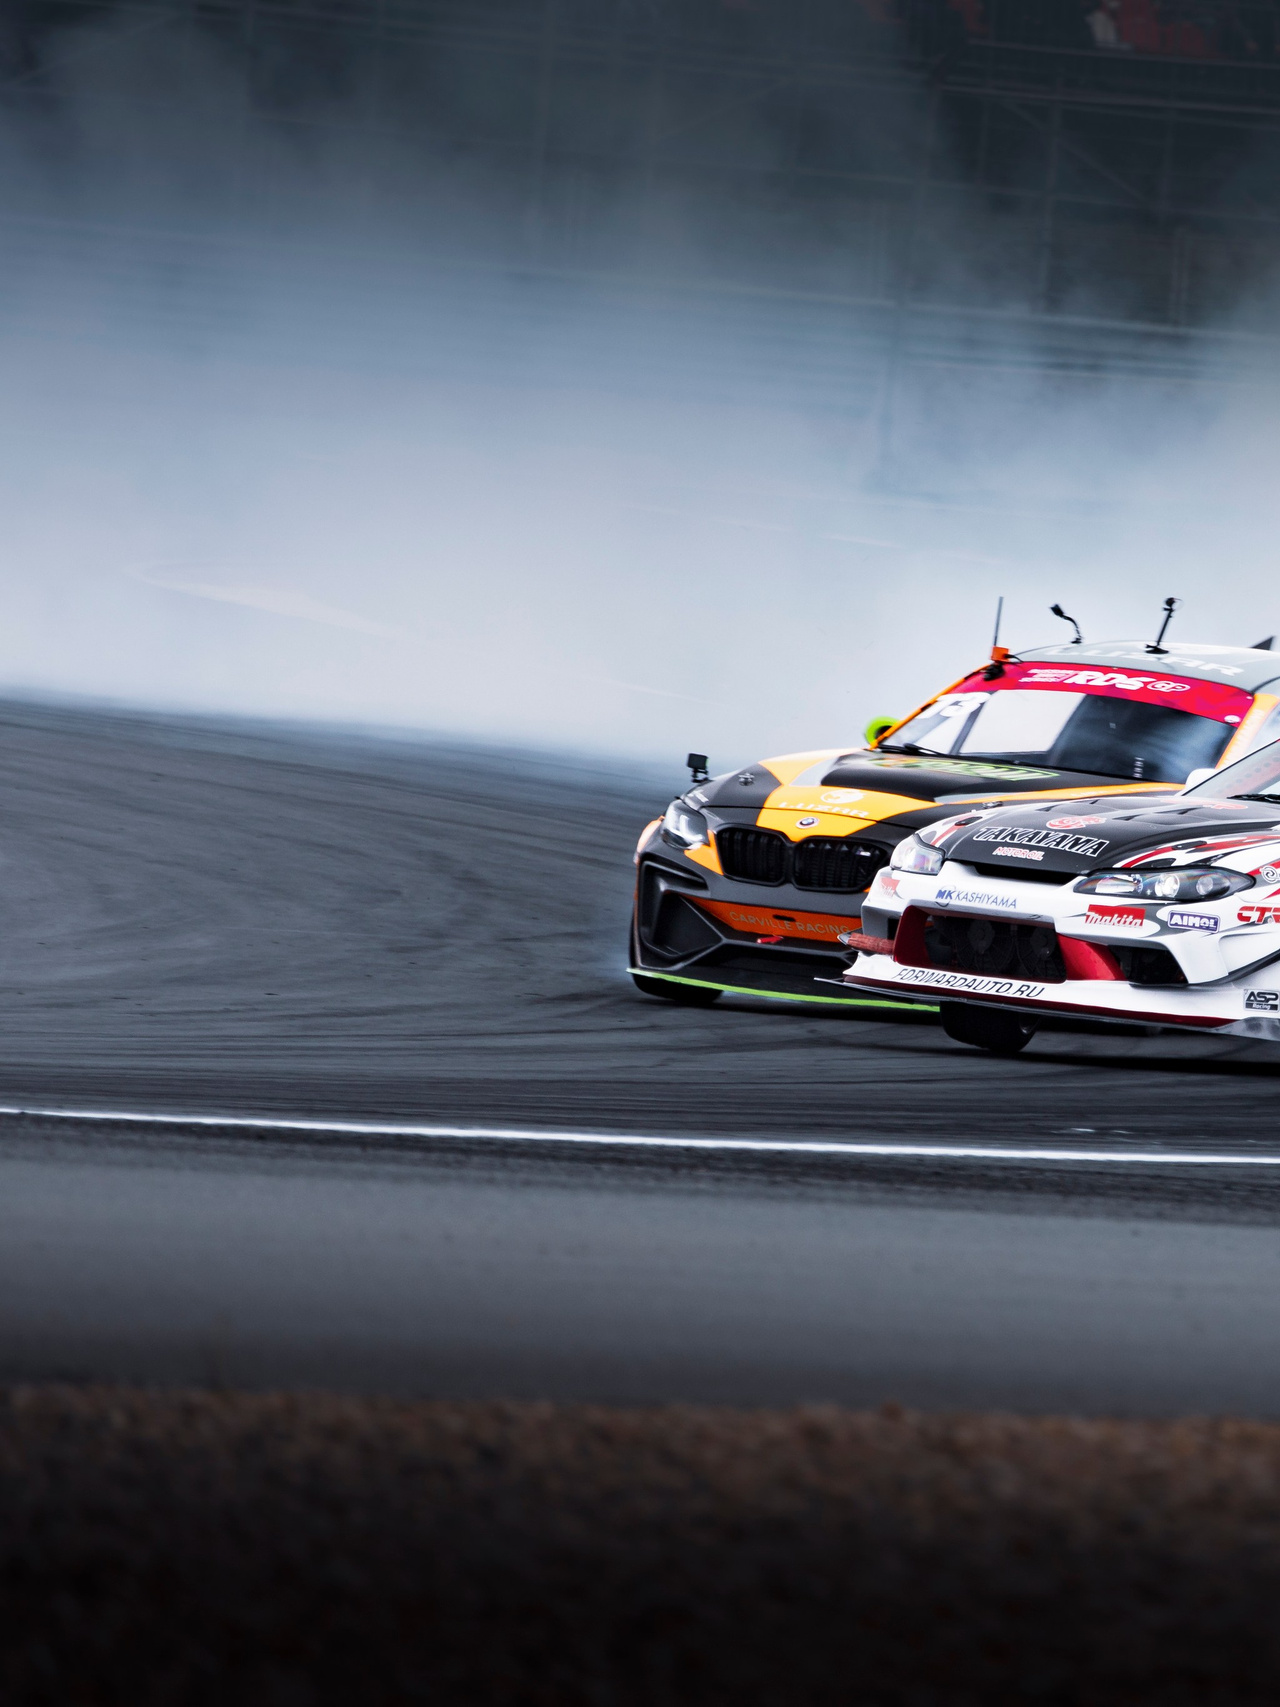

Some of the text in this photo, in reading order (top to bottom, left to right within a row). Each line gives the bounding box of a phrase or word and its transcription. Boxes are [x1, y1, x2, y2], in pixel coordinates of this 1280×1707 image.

[1063, 670, 1156, 690] RDS
[973, 827, 1109, 857] TAKAYAMA
[992, 847, 1045, 861] MOTOR OIL
[955, 891, 1017, 908] KASHIYAMA
[729, 911, 850, 935] CARVILLE RACING
[1170, 914, 1217, 929] AIMOL
[892, 968, 1045, 998] FORWARDAUTO.RU
[1246, 991, 1279, 1004] ASP
